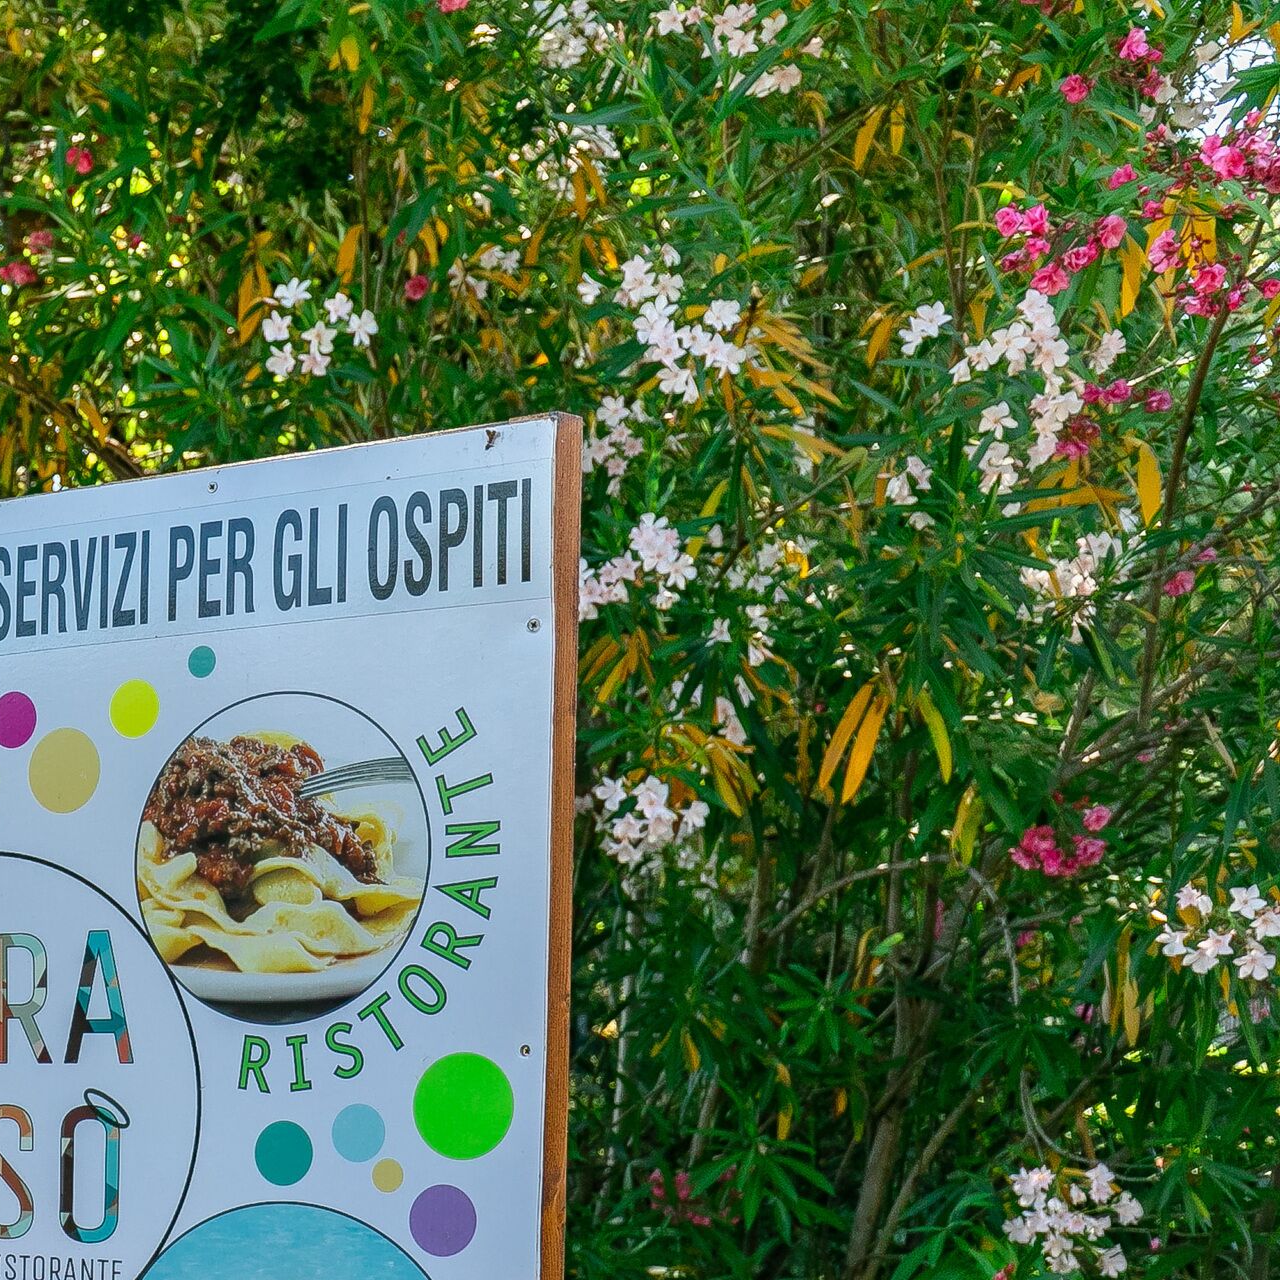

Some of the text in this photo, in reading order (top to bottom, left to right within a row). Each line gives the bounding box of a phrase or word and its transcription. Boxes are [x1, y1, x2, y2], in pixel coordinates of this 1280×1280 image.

[168, 517, 254, 620] PER
[273, 504, 348, 609] GLI
[368, 478, 533, 599] OSPITI
[237, 707, 502, 1094] RISTORANTE
